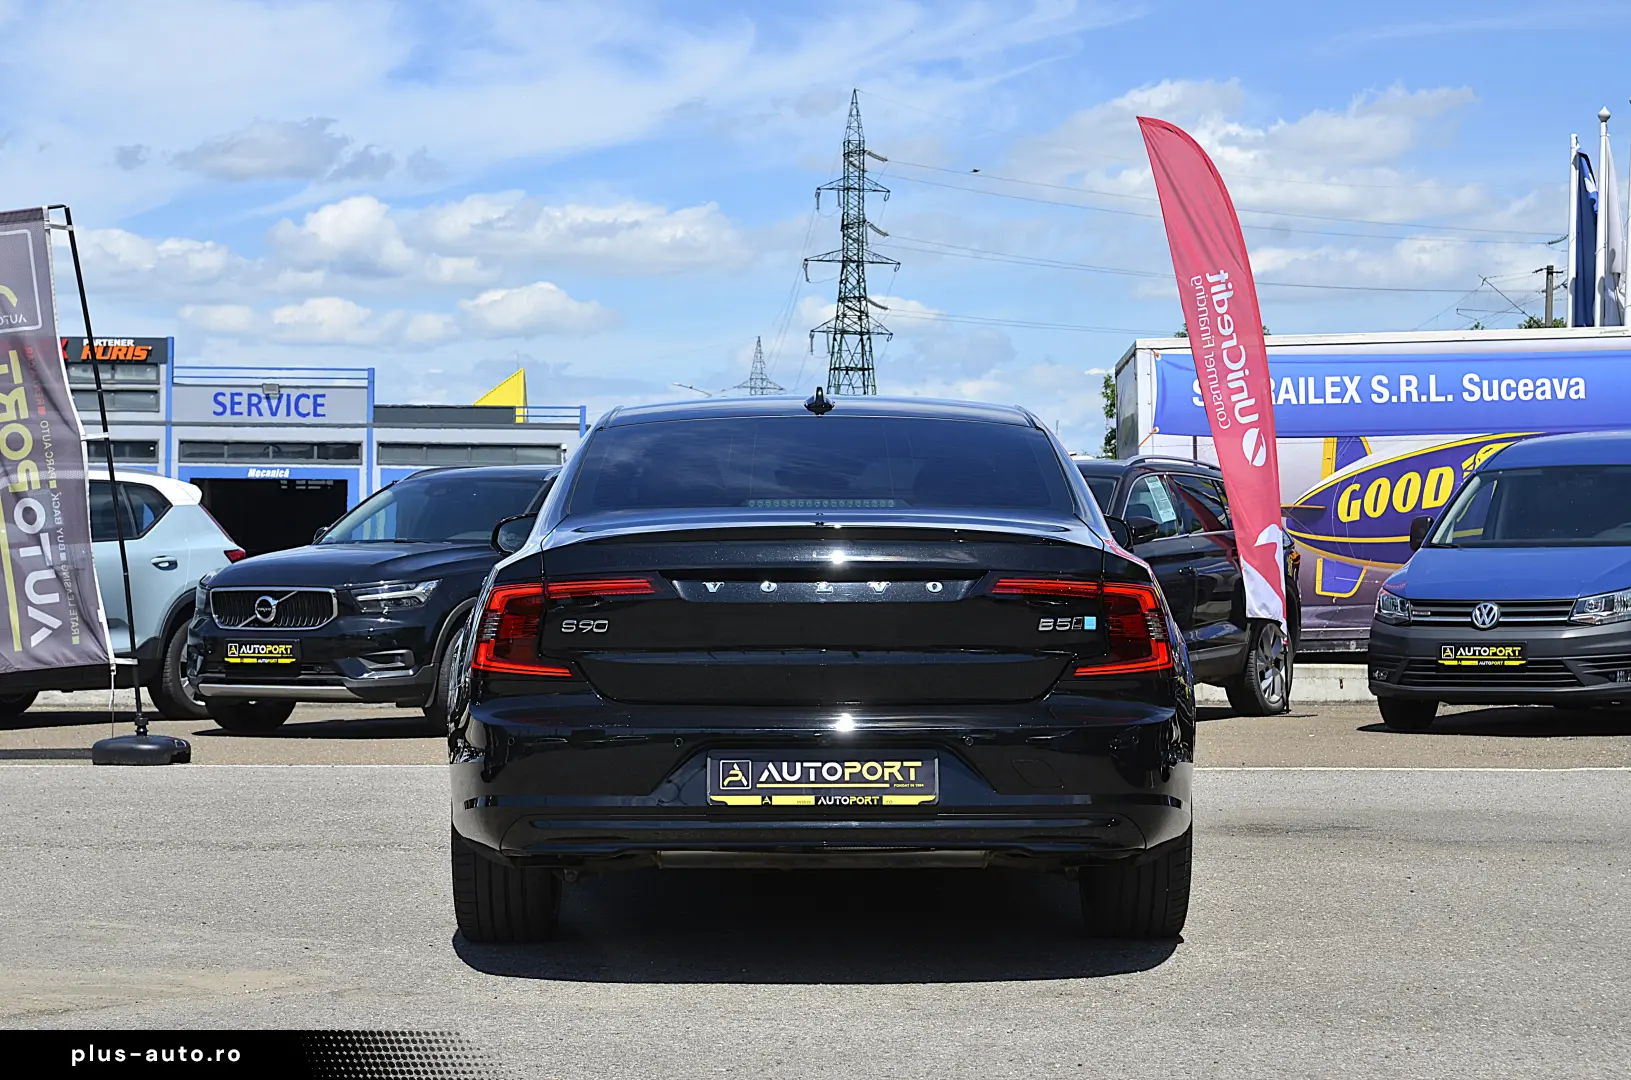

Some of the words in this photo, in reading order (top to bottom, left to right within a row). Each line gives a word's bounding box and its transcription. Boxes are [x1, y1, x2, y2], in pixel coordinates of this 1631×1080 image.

[83, 338, 135, 347] PRTENER
[1370, 374, 1454, 404] S.R.L.
[1462, 373, 1586, 402] Suceava
[212, 391, 327, 418] SERVICE
[702, 581, 944, 594] VOLVO
[561, 619, 609, 633] S90
[239, 644, 293, 654] AUTOPORT
[1456, 647, 1521, 656] AUTOPORT
[758, 761, 923, 782] AUTOPORT
[817, 795, 880, 806] AUTOPORT
